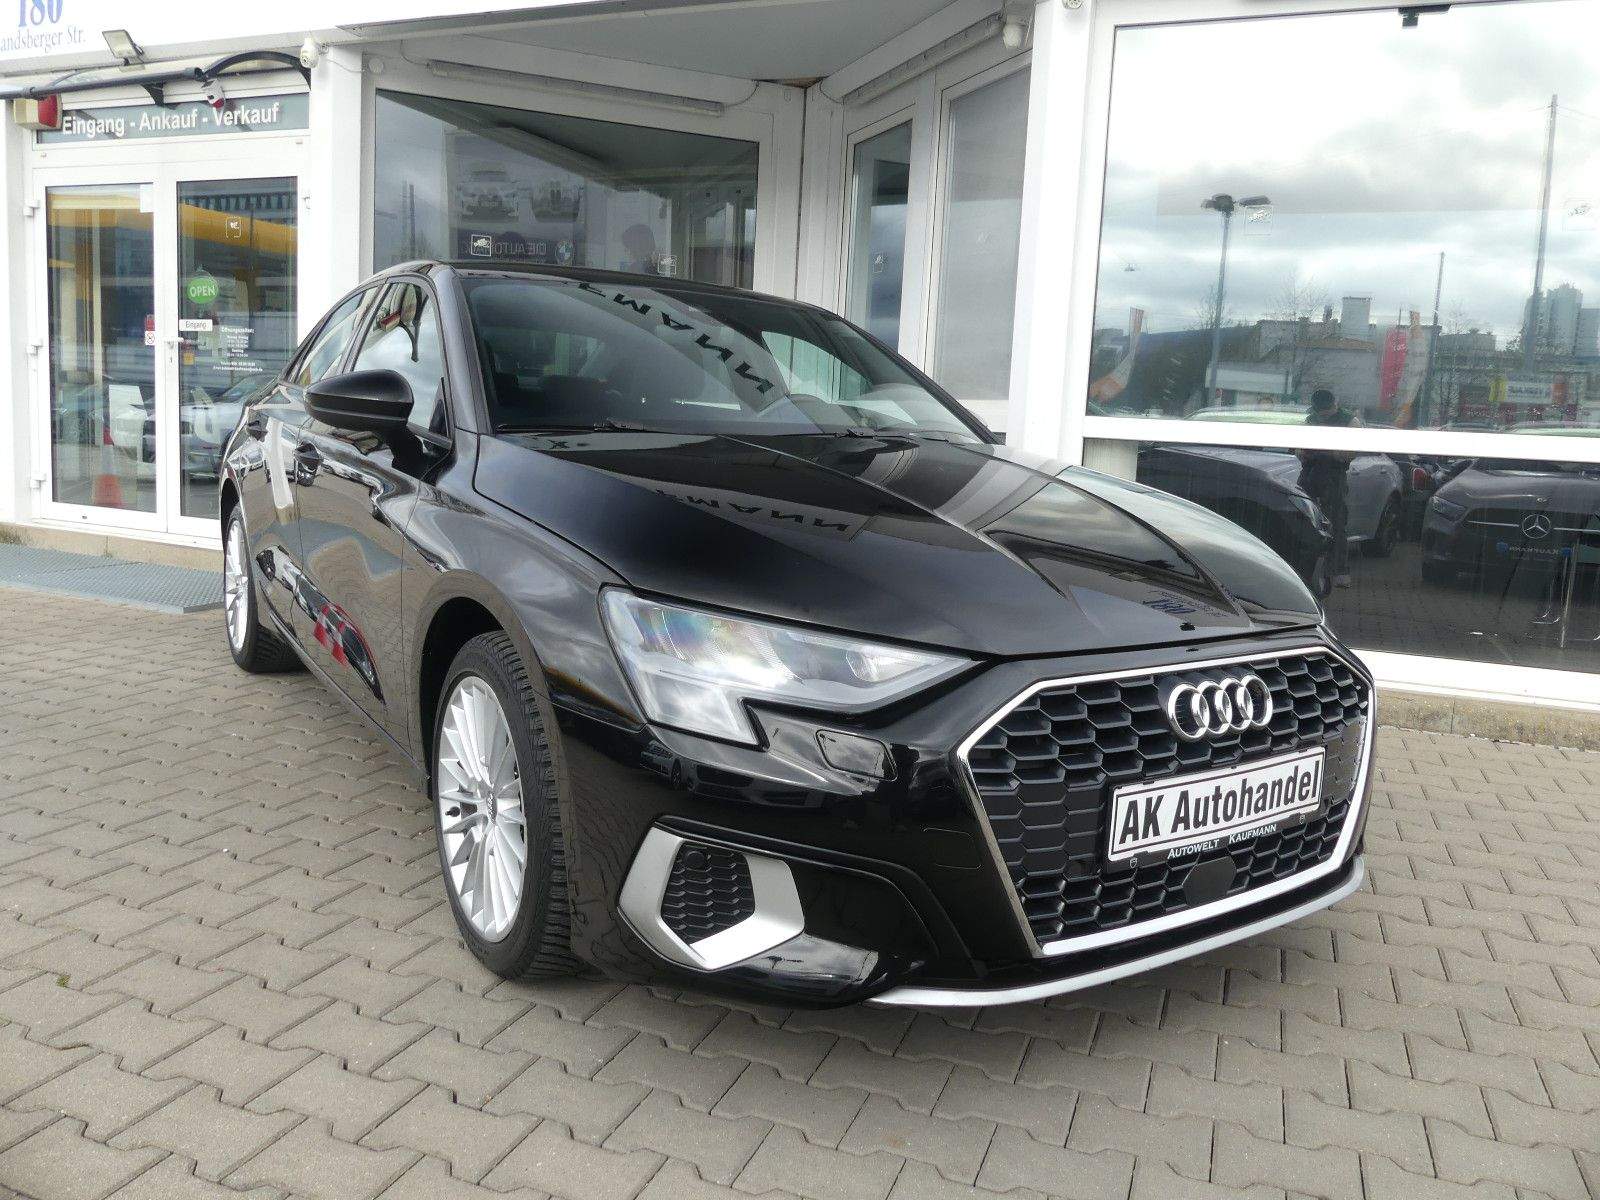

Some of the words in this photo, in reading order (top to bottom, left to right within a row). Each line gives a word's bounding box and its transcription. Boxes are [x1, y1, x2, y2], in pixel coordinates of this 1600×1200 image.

[18, 0, 64, 28] 180
[0, 30, 64, 54] andsberger
[67, 26, 87, 46] Str.
[62, 114, 126, 139] Eingang
[139, 111, 199, 133] Ankauf
[214, 103, 281, 128] Verkauf
[189, 286, 216, 298] OPEN
[185, 320, 207, 330] Eingang
[1118, 794, 1166, 846] AK
[1170, 760, 1321, 834] Autohandel
[1167, 838, 1221, 860] AUTOWELT
[1228, 823, 1277, 845] KAUFMANN
